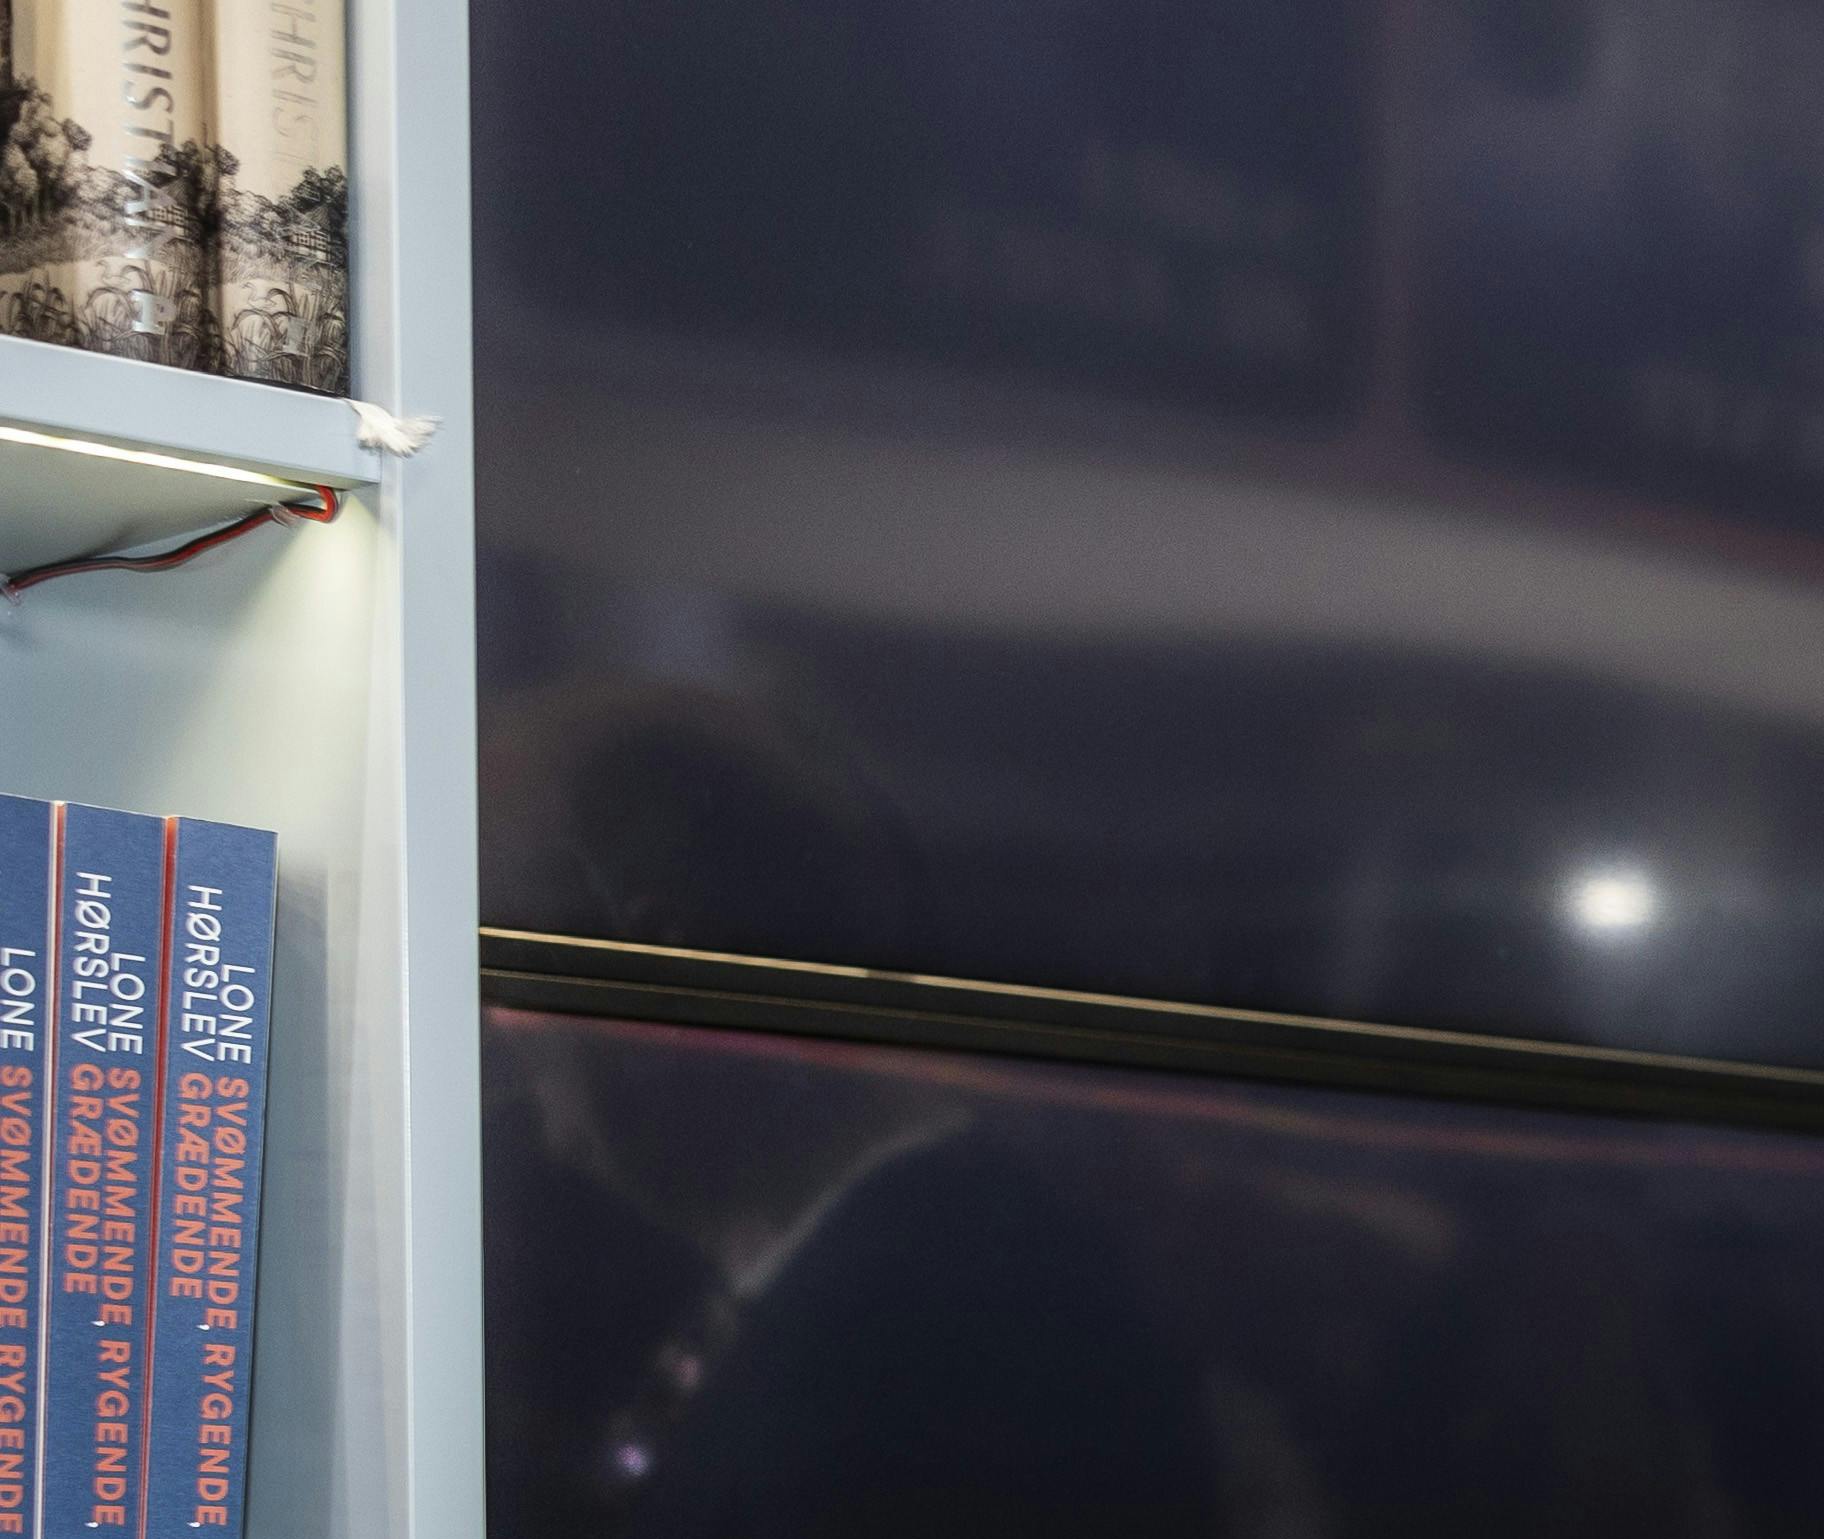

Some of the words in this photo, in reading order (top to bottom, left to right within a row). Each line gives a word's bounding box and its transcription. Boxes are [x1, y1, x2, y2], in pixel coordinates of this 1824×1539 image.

[0, 947, 36, 1052] LONE
[70, 871, 113, 1053] HØRSLEV
[107, 952, 146, 1055] LONE
[180, 885, 223, 1062] HØRSLEV
[216, 963, 256, 1065] LONE
[63, 1063, 104, 1295] GRÆDENDE
[90, 1068, 142, 1327] SVØMMENDE,
[170, 1073, 213, 1300] GRÆDENDE
[196, 1077, 249, 1330] SVØMMENDE,
[84, 1339, 132, 1528] RYGENDE,
[187, 1343, 236, 1528] RYGENDE,
